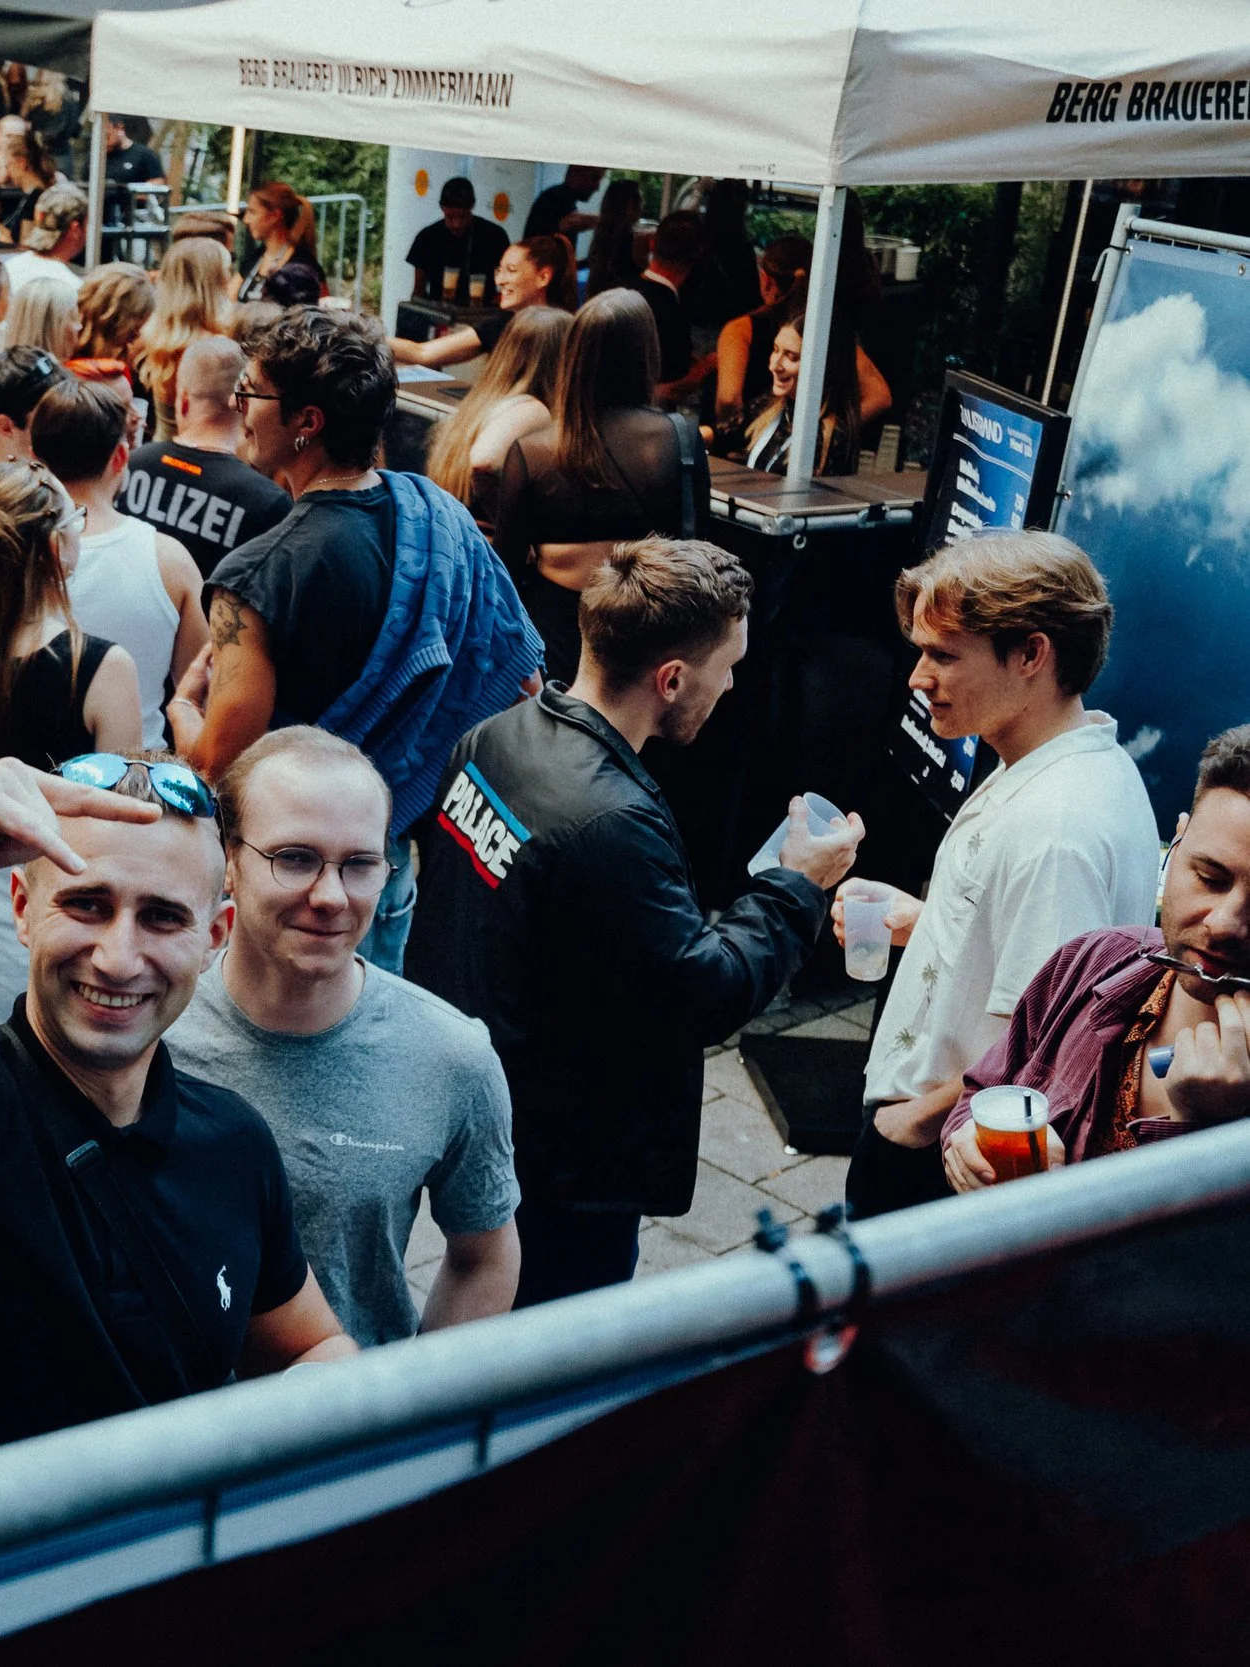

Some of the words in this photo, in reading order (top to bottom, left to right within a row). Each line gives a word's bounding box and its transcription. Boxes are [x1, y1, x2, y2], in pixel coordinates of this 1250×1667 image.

[239, 58, 268, 87] BERG
[273, 60, 333, 92] BRAUEREI
[337, 64, 388, 97] ULRICH
[391, 68, 514, 107] ZIMMERMANN
[1045, 81, 1123, 123] BERG
[1126, 80, 1250, 122] BRAUERE
[441, 770, 522, 880] PALACE
[329, 1133, 406, 1154] Champion
